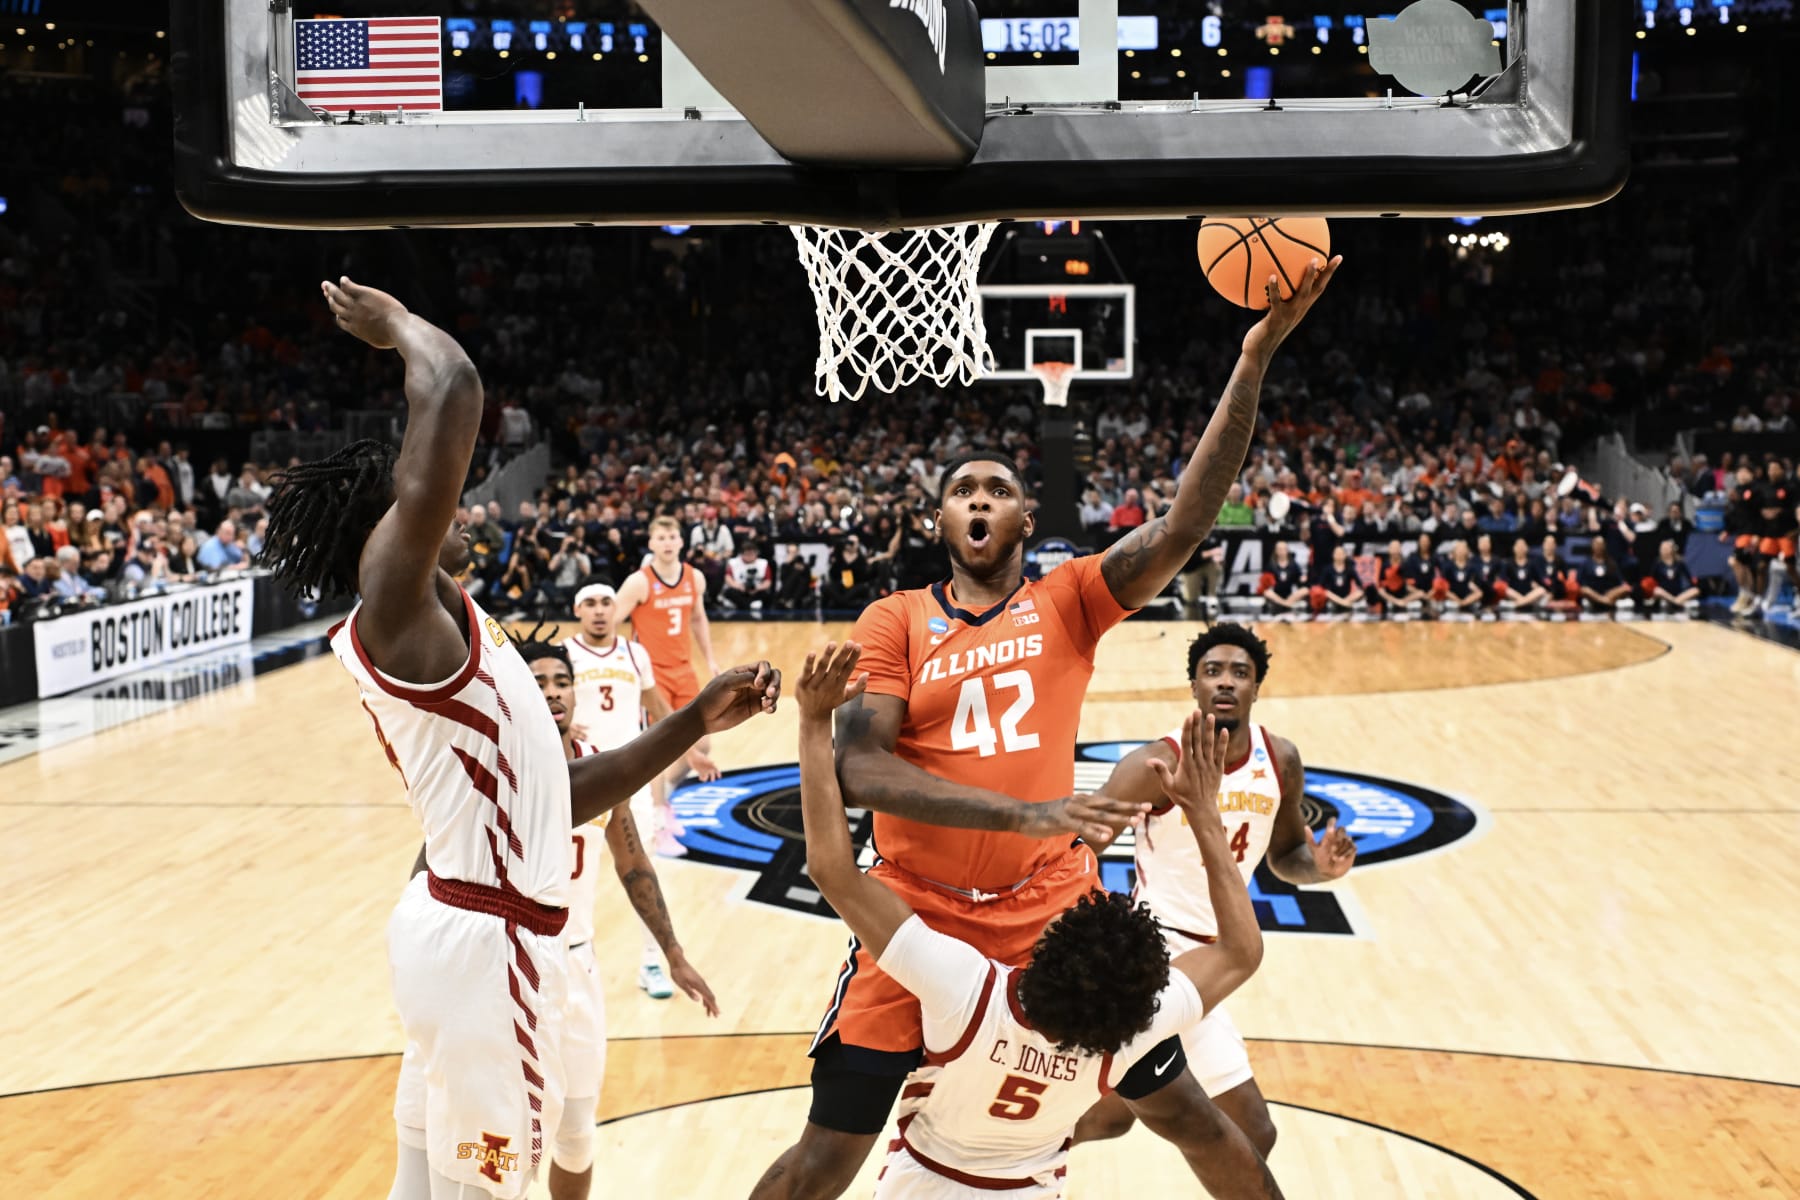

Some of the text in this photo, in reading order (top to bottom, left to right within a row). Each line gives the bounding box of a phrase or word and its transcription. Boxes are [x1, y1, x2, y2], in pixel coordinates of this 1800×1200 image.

[1004, 23, 1071, 51] 15:02
[1201, 15, 1221, 47] 6
[91, 605, 165, 672] BOSTON
[170, 590, 242, 649] COLLEGE
[667, 608, 683, 636] 3
[920, 634, 1043, 684] ILLINOIS
[599, 685, 614, 712] 3
[950, 670, 1040, 758] 42
[989, 1039, 1078, 1081] C. JONES
[988, 1073, 1050, 1121] 5
